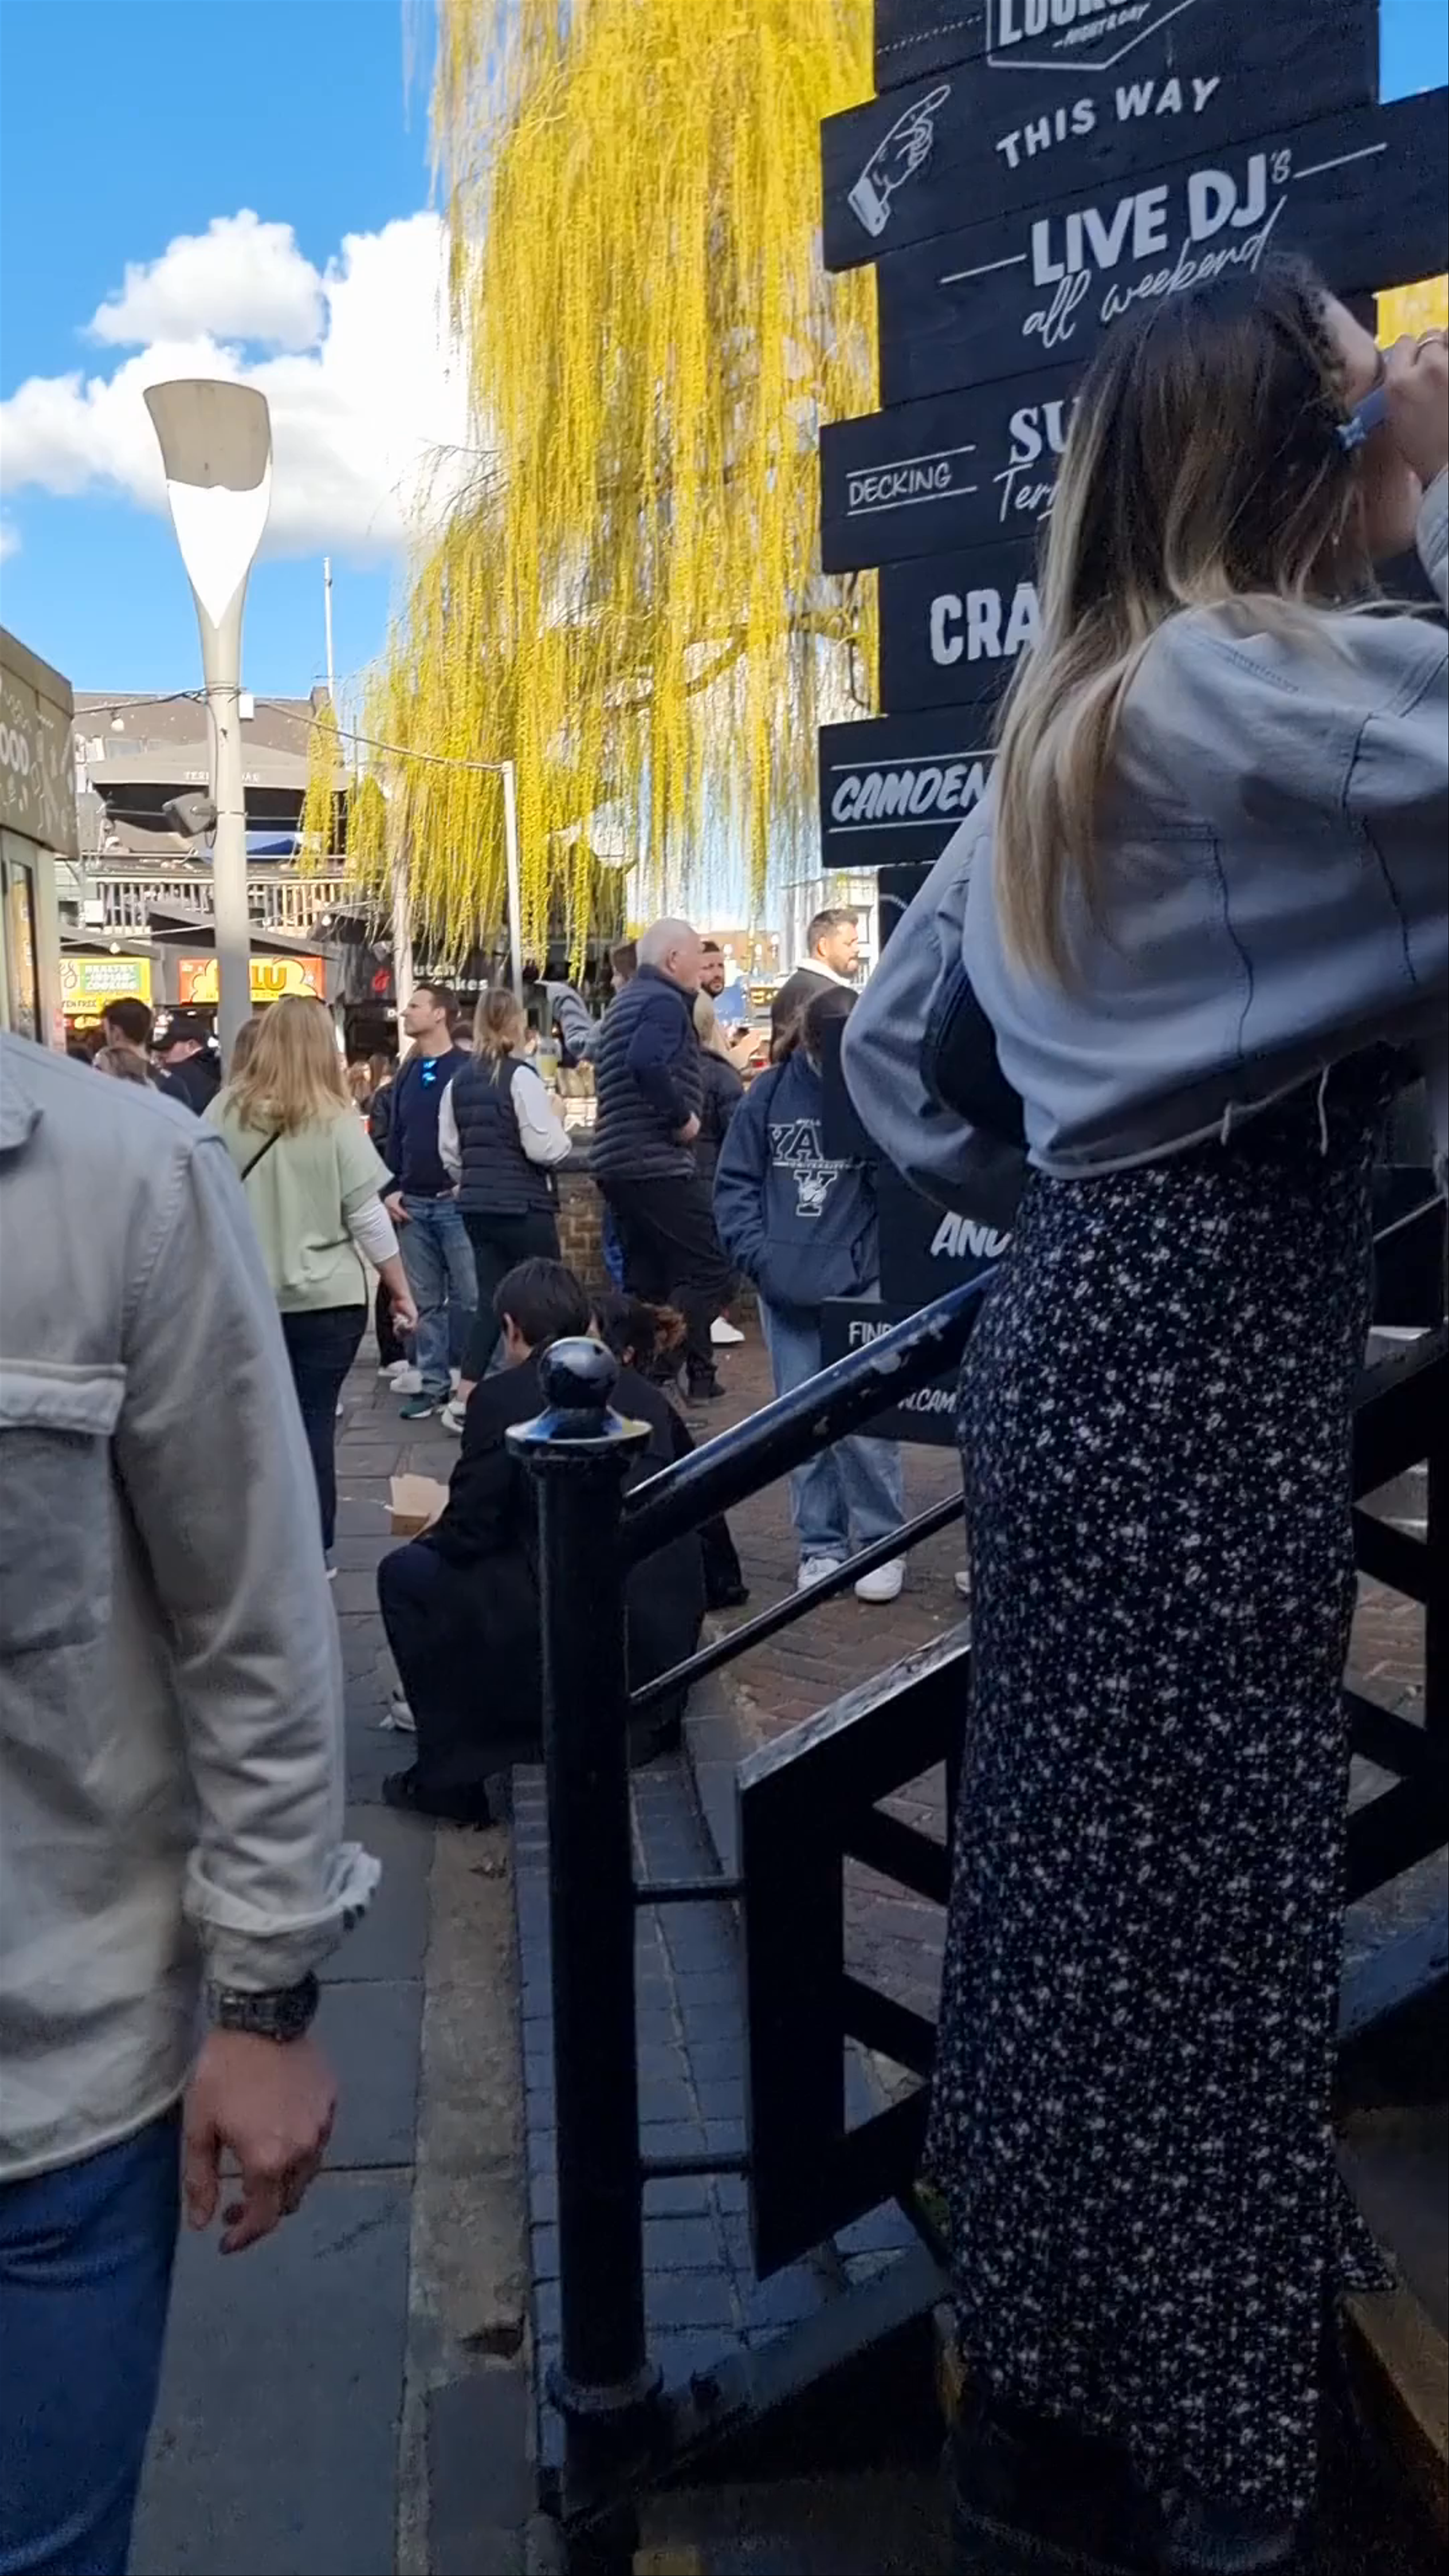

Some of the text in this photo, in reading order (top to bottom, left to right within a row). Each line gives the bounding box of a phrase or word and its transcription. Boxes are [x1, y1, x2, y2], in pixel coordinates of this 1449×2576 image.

[996, 77, 1220, 168] THIS WAY
[1022, 194, 1287, 349] all weekend
[1032, 184, 1168, 286] LIVE
[849, 462, 952, 508] DECKING
[930, 583, 1041, 665] CRA
[831, 761, 987, 823] CAMDEN
